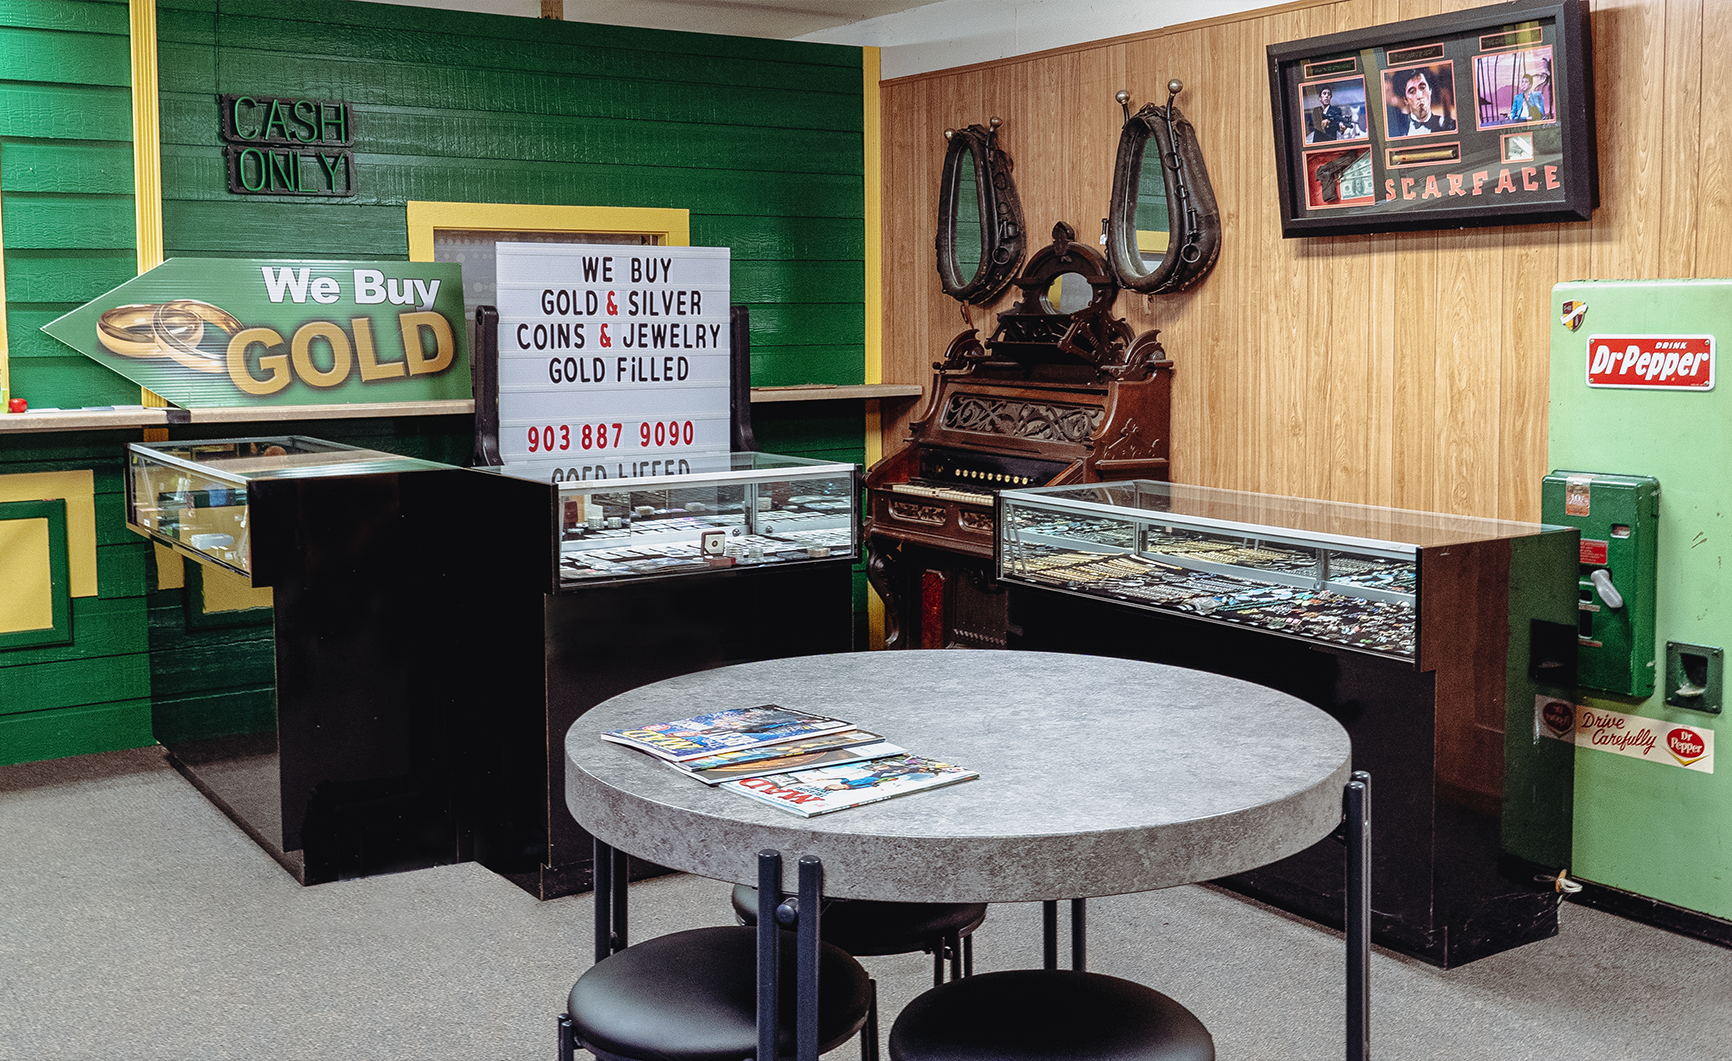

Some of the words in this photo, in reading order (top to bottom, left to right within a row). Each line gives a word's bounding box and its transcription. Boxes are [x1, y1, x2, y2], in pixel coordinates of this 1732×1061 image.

[234, 96, 346, 144] CASH
[239, 147, 345, 193] ONLY
[1384, 165, 1561, 202] SCARFACE
[582, 256, 613, 283] WE
[631, 257, 672, 283] BUY
[260, 266, 341, 304] We
[353, 269, 441, 312] Buy
[541, 289, 598, 316] GOLD
[606, 290, 618, 316] &
[628, 290, 702, 316] SILVER
[517, 323, 585, 350] COINS
[599, 323, 611, 348] &
[623, 323, 721, 349] JEWELRY
[1655, 341, 1688, 350] DRINK
[226, 310, 455, 396] GOLD
[549, 357, 606, 384] GOLD
[528, 424, 570, 453] 903
[581, 423, 623, 450] 887
[640, 420, 694, 448] 9090
[1580, 711, 1625, 730] Drive
[1591, 728, 1658, 756] Carefully
[1670, 737, 1703, 754] Pepper
[1681, 731, 1693, 741] Dr
[738, 778, 825, 804] MAD
